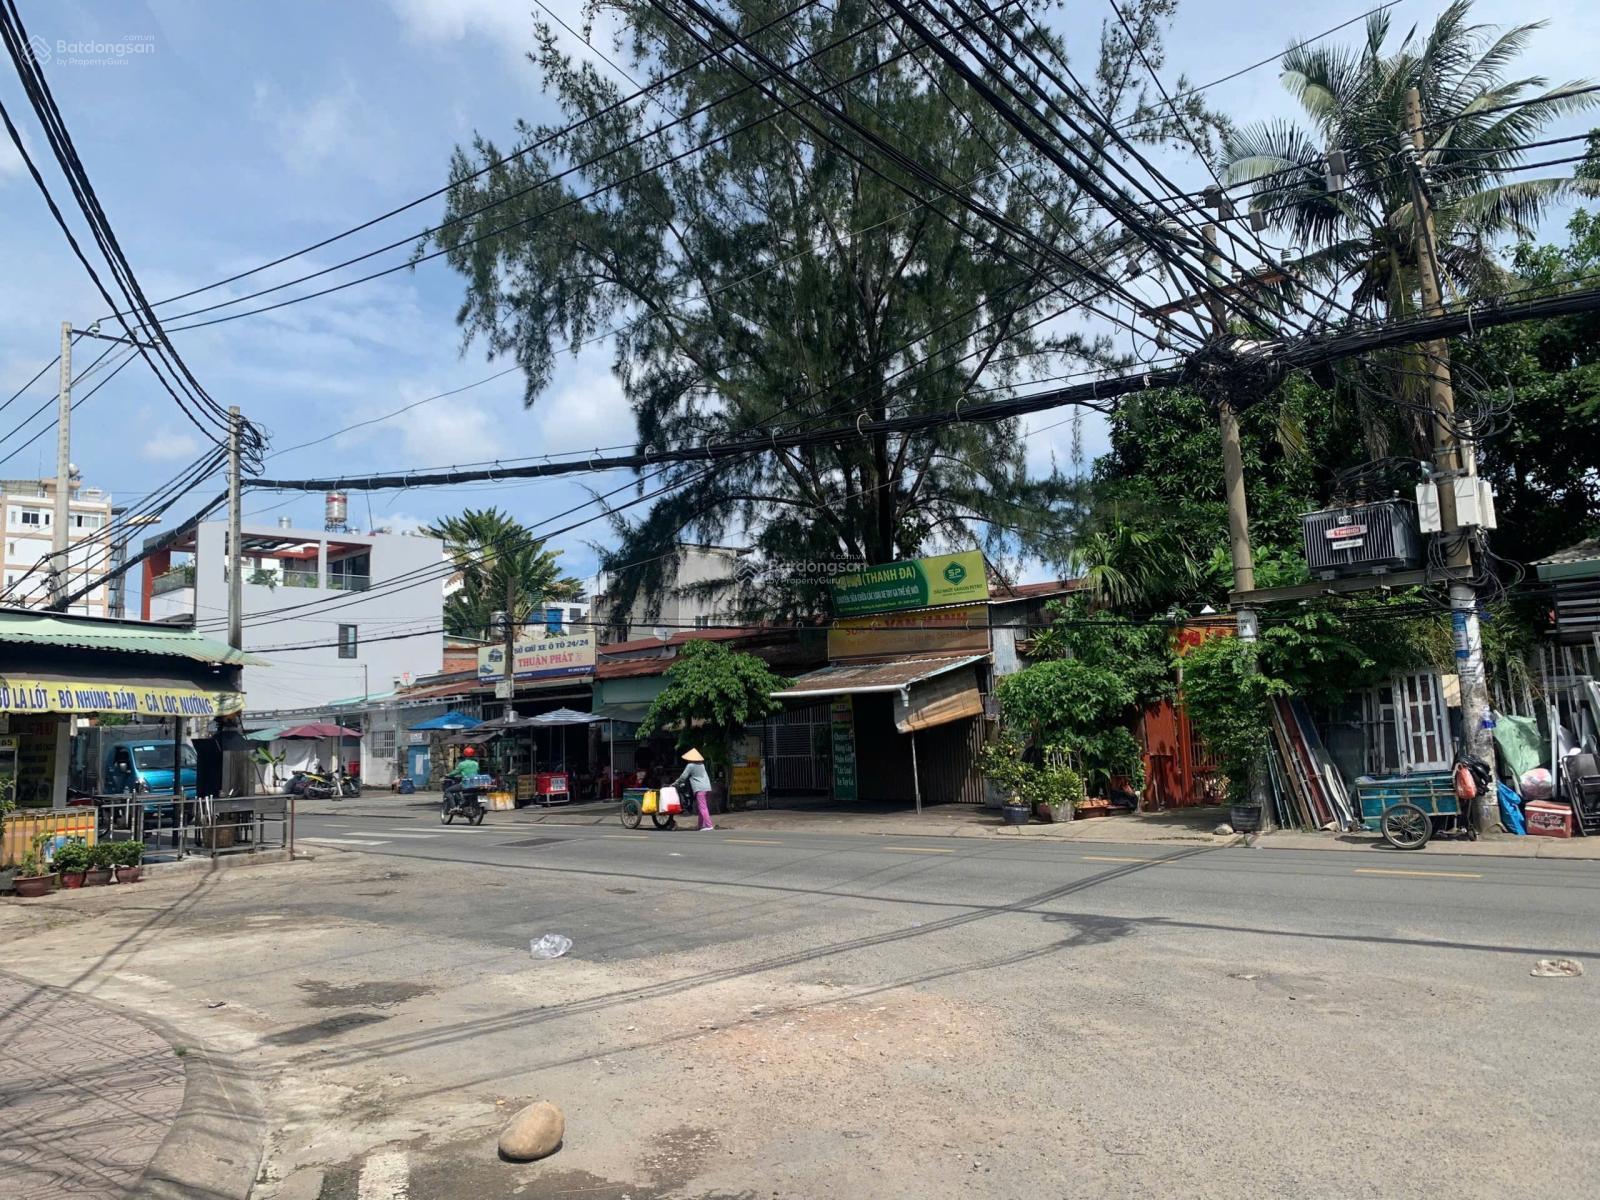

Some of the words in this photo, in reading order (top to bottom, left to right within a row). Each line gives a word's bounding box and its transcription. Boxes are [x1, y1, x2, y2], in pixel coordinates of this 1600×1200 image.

[537, 644, 547, 652] XE
[567, 638, 589, 648] 24/24
[517, 654, 549, 669] THUẬN
[550, 650, 574, 665] PHÁT
[29, 682, 48, 709] LỐT
[57, 685, 74, 709] BÒ
[74, 686, 113, 710] NHÚNG
[145, 690, 160, 712] CÁ
[160, 691, 179, 714] LÓC
[179, 693, 214, 714] NƯỚNG
